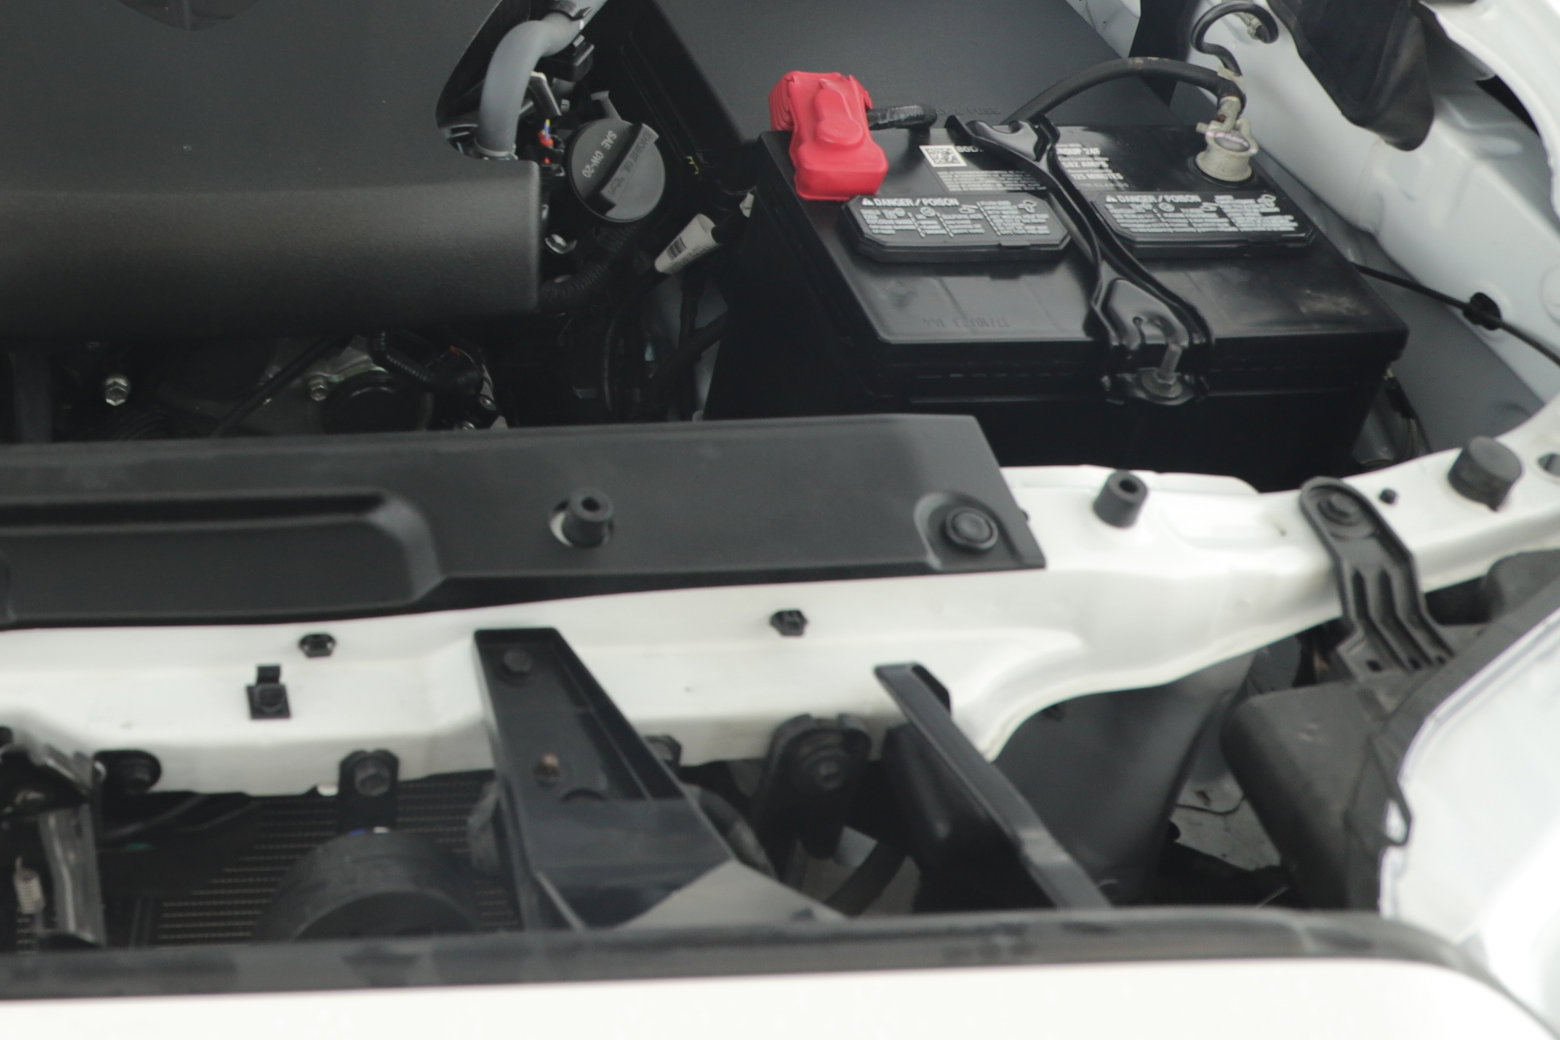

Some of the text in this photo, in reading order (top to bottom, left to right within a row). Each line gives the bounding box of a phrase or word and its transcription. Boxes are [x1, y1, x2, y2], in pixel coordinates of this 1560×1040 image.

[582, 130, 618, 179] SAE 0W-20
[872, 197, 914, 207] DANGER
[921, 197, 960, 207] POISON
